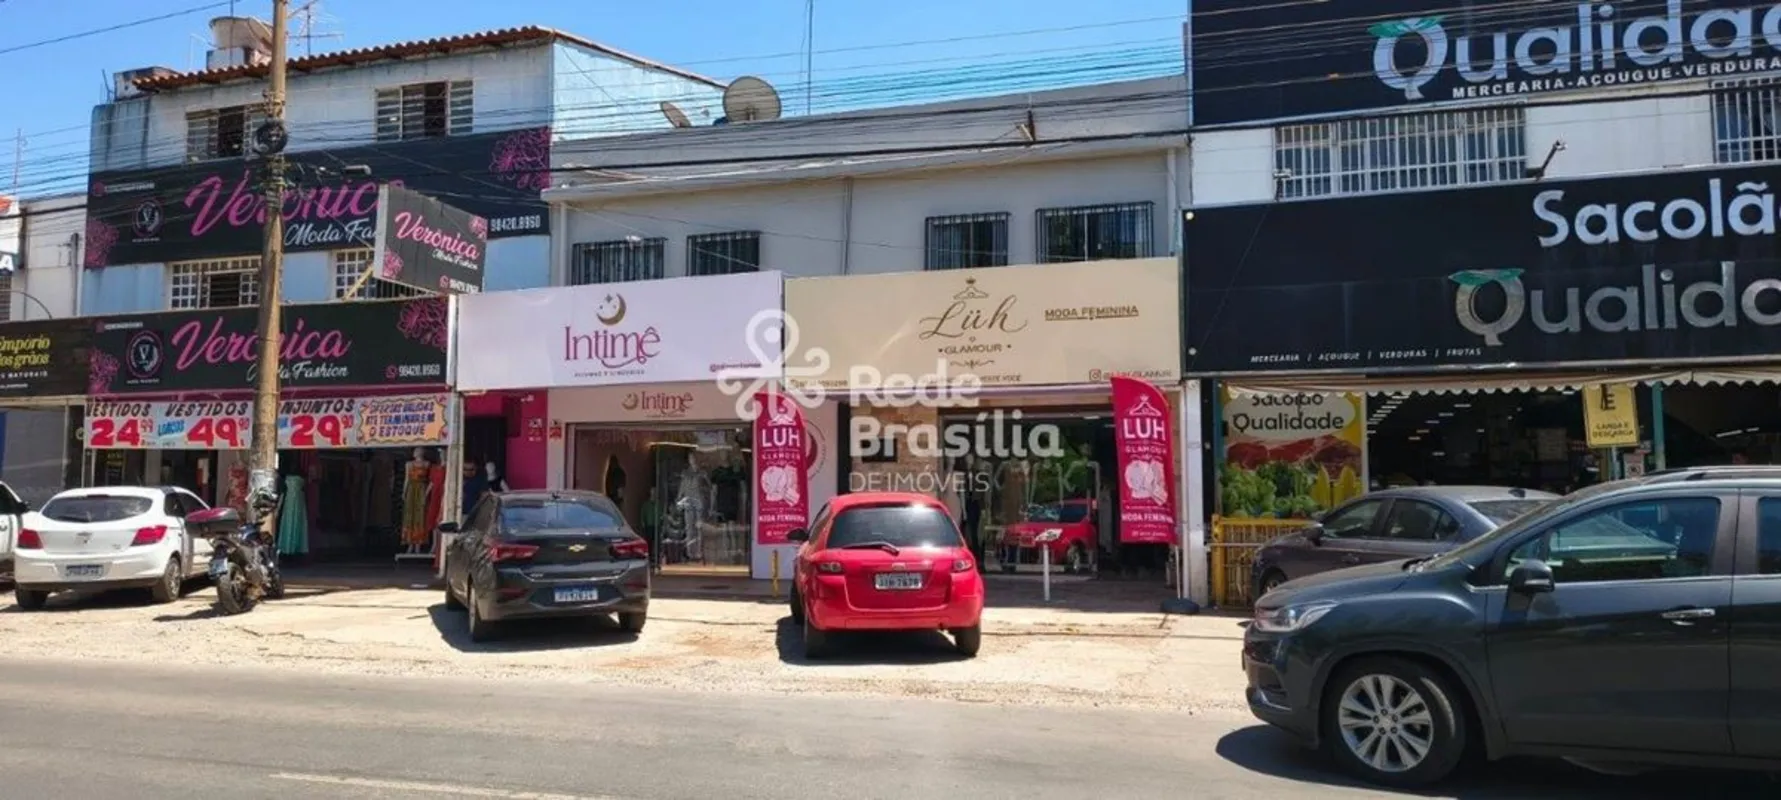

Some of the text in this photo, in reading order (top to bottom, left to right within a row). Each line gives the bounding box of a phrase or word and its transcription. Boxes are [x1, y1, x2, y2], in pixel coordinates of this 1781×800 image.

[1532, 178, 1781, 247] Sacolã
[285, 222, 342, 246] Moda
[1044, 305, 1139, 319] MODA FEMININA
[564, 326, 661, 369] Intimê
[944, 343, 1002, 355] GLAMOUR
[1250, 354, 1300, 363] MERCEARIA
[1379, 350, 1428, 359] VERDURAS
[1446, 348, 1482, 357] FRUTAS
[291, 360, 349, 380] Fashion
[85, 402, 152, 418] VESTIDOS
[165, 401, 249, 418] VESTIDOS
[280, 398, 355, 415] NJUNTOS
[379, 425, 425, 438] ESTOQUE
[1123, 417, 1166, 441] LUH
[1233, 412, 1345, 433] Qualidade
[762, 427, 801, 448] LUH
